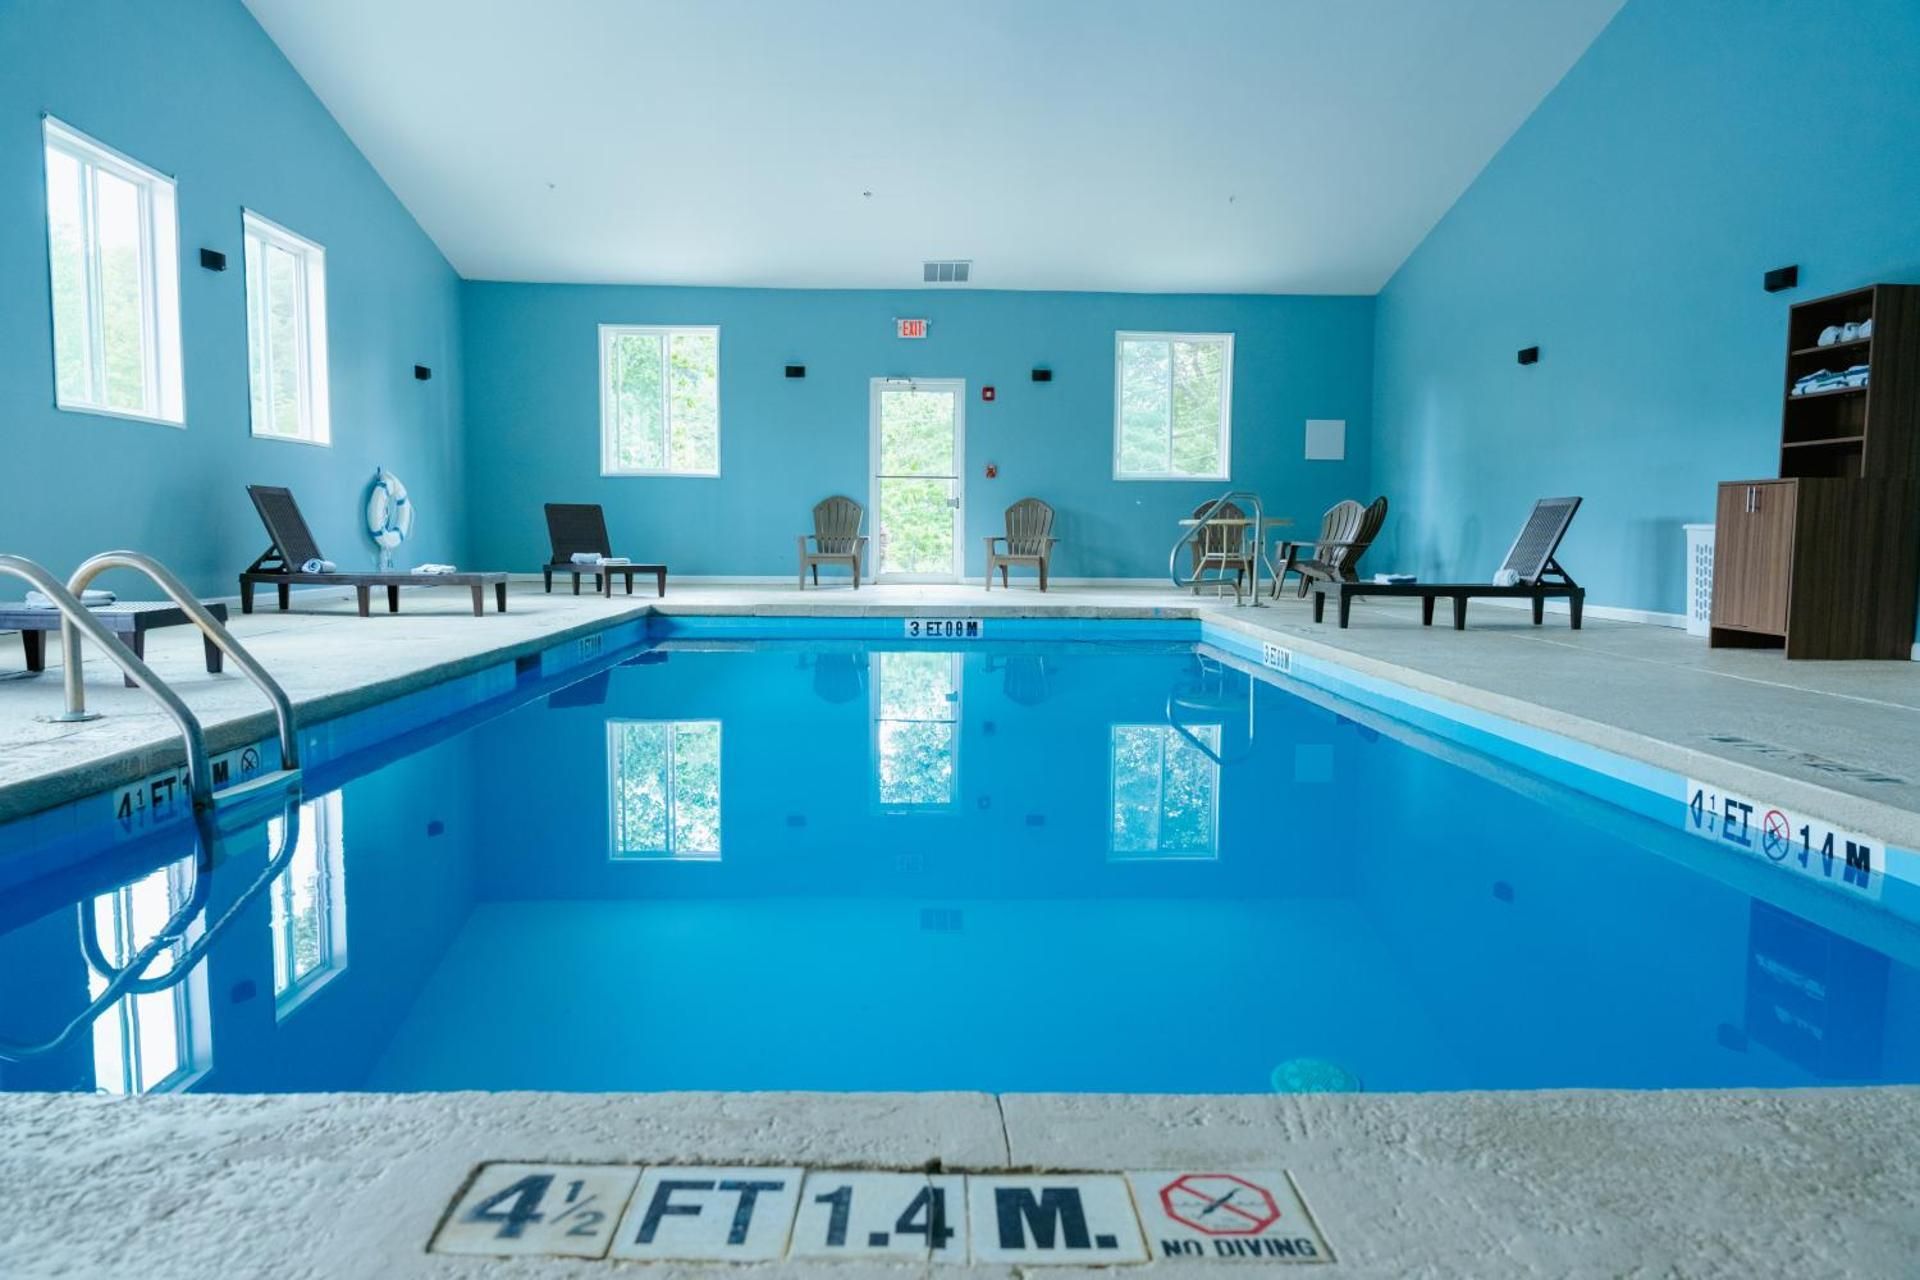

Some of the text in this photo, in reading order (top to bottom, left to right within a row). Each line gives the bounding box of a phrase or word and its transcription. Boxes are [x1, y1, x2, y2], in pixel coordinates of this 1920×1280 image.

[902, 320, 923, 336] EXIT
[1846, 840, 1871, 873] M
[634, 1180, 786, 1245] FT
[814, 1185, 955, 1249] 1.4
[995, 1187, 1119, 1250] M.
[1160, 1237, 1319, 1258] NO DIVING
